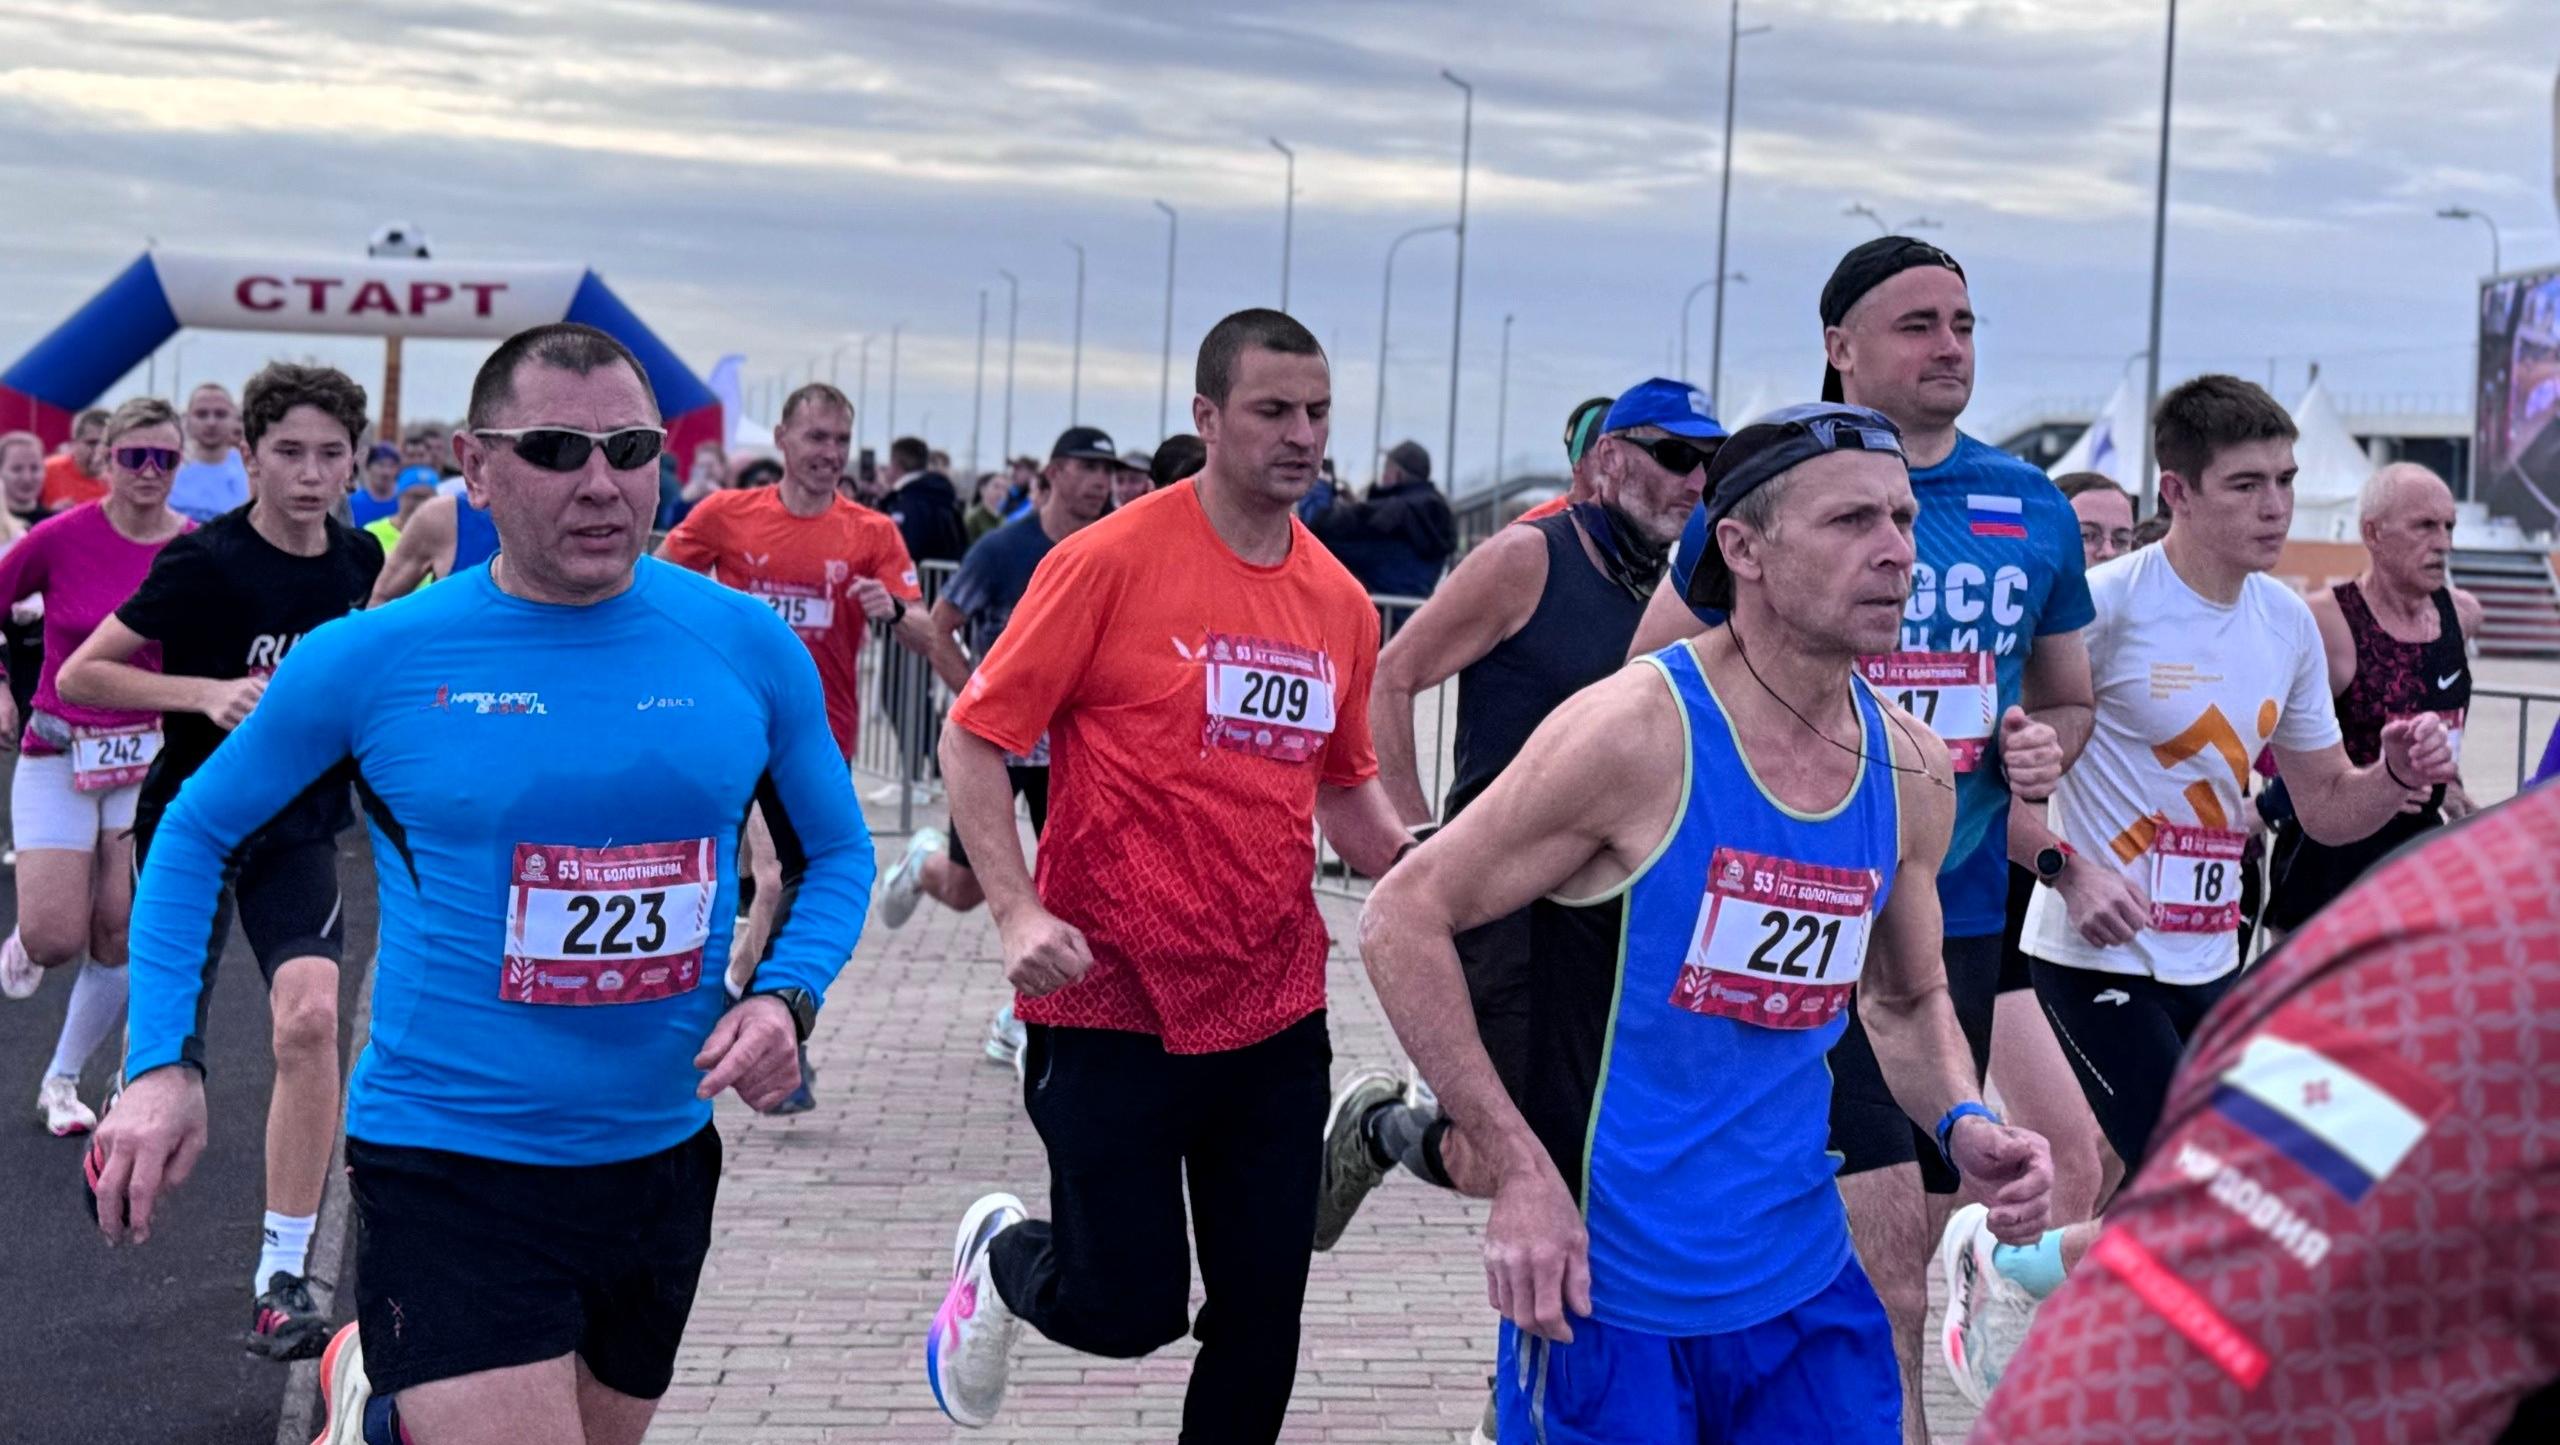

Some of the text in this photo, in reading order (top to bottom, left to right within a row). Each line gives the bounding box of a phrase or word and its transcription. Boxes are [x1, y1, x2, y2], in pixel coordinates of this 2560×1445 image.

[235, 275, 508, 317] СТАРТ
[1903, 561, 2028, 627] ОСС
[246, 633, 301, 666] RU
[1901, 625, 2017, 656] ЦИИ
[1240, 671, 1309, 722] 209
[1897, 689, 1939, 727] 17
[98, 736, 143, 765] 242
[558, 860, 579, 880] 53
[1753, 870, 1775, 893] 53
[1779, 883, 1797, 898] П.Г.
[2193, 861, 2224, 903] 18
[562, 891, 667, 954] 223
[1747, 910, 1842, 978] 221
